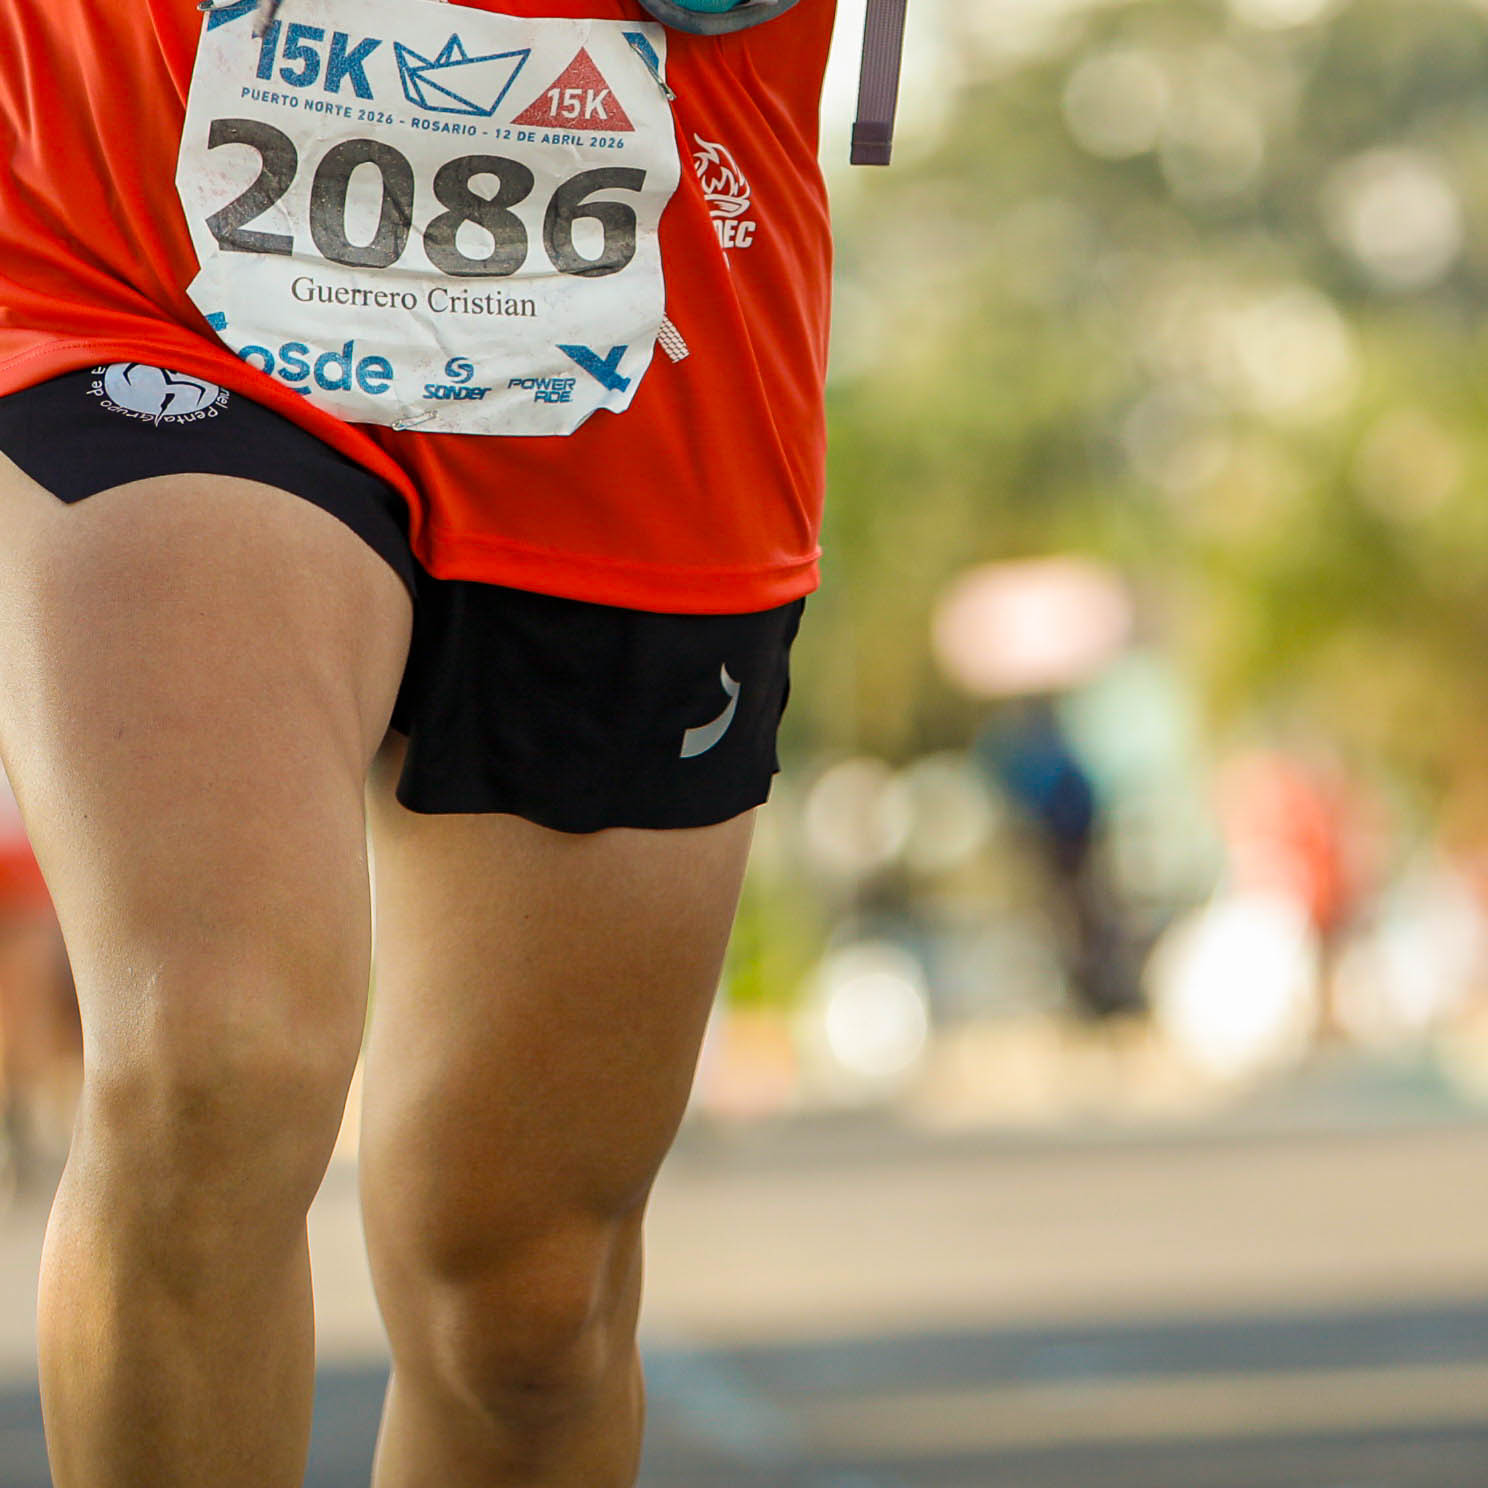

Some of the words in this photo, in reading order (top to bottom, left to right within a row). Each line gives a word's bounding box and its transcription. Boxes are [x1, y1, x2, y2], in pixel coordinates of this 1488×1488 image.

[252, 20, 382, 100] 15K
[241, 87, 298, 108] PUERTO
[304, 99, 352, 118] NORTE
[358, 109, 393, 125] 2026
[411, 118, 477, 136] ROSARIO
[496, 129, 511, 140] 12
[517, 131, 535, 143] DE
[541, 133, 584, 146] ABRIL
[590, 136, 624, 149] 2026
[547, 88, 612, 120] 15K
[205, 118, 647, 278] 2086
[291, 277, 417, 311] Guerrero
[427, 287, 537, 318] Cristian
[238, 339, 394, 395] osde
[507, 378, 576, 391] POWER
